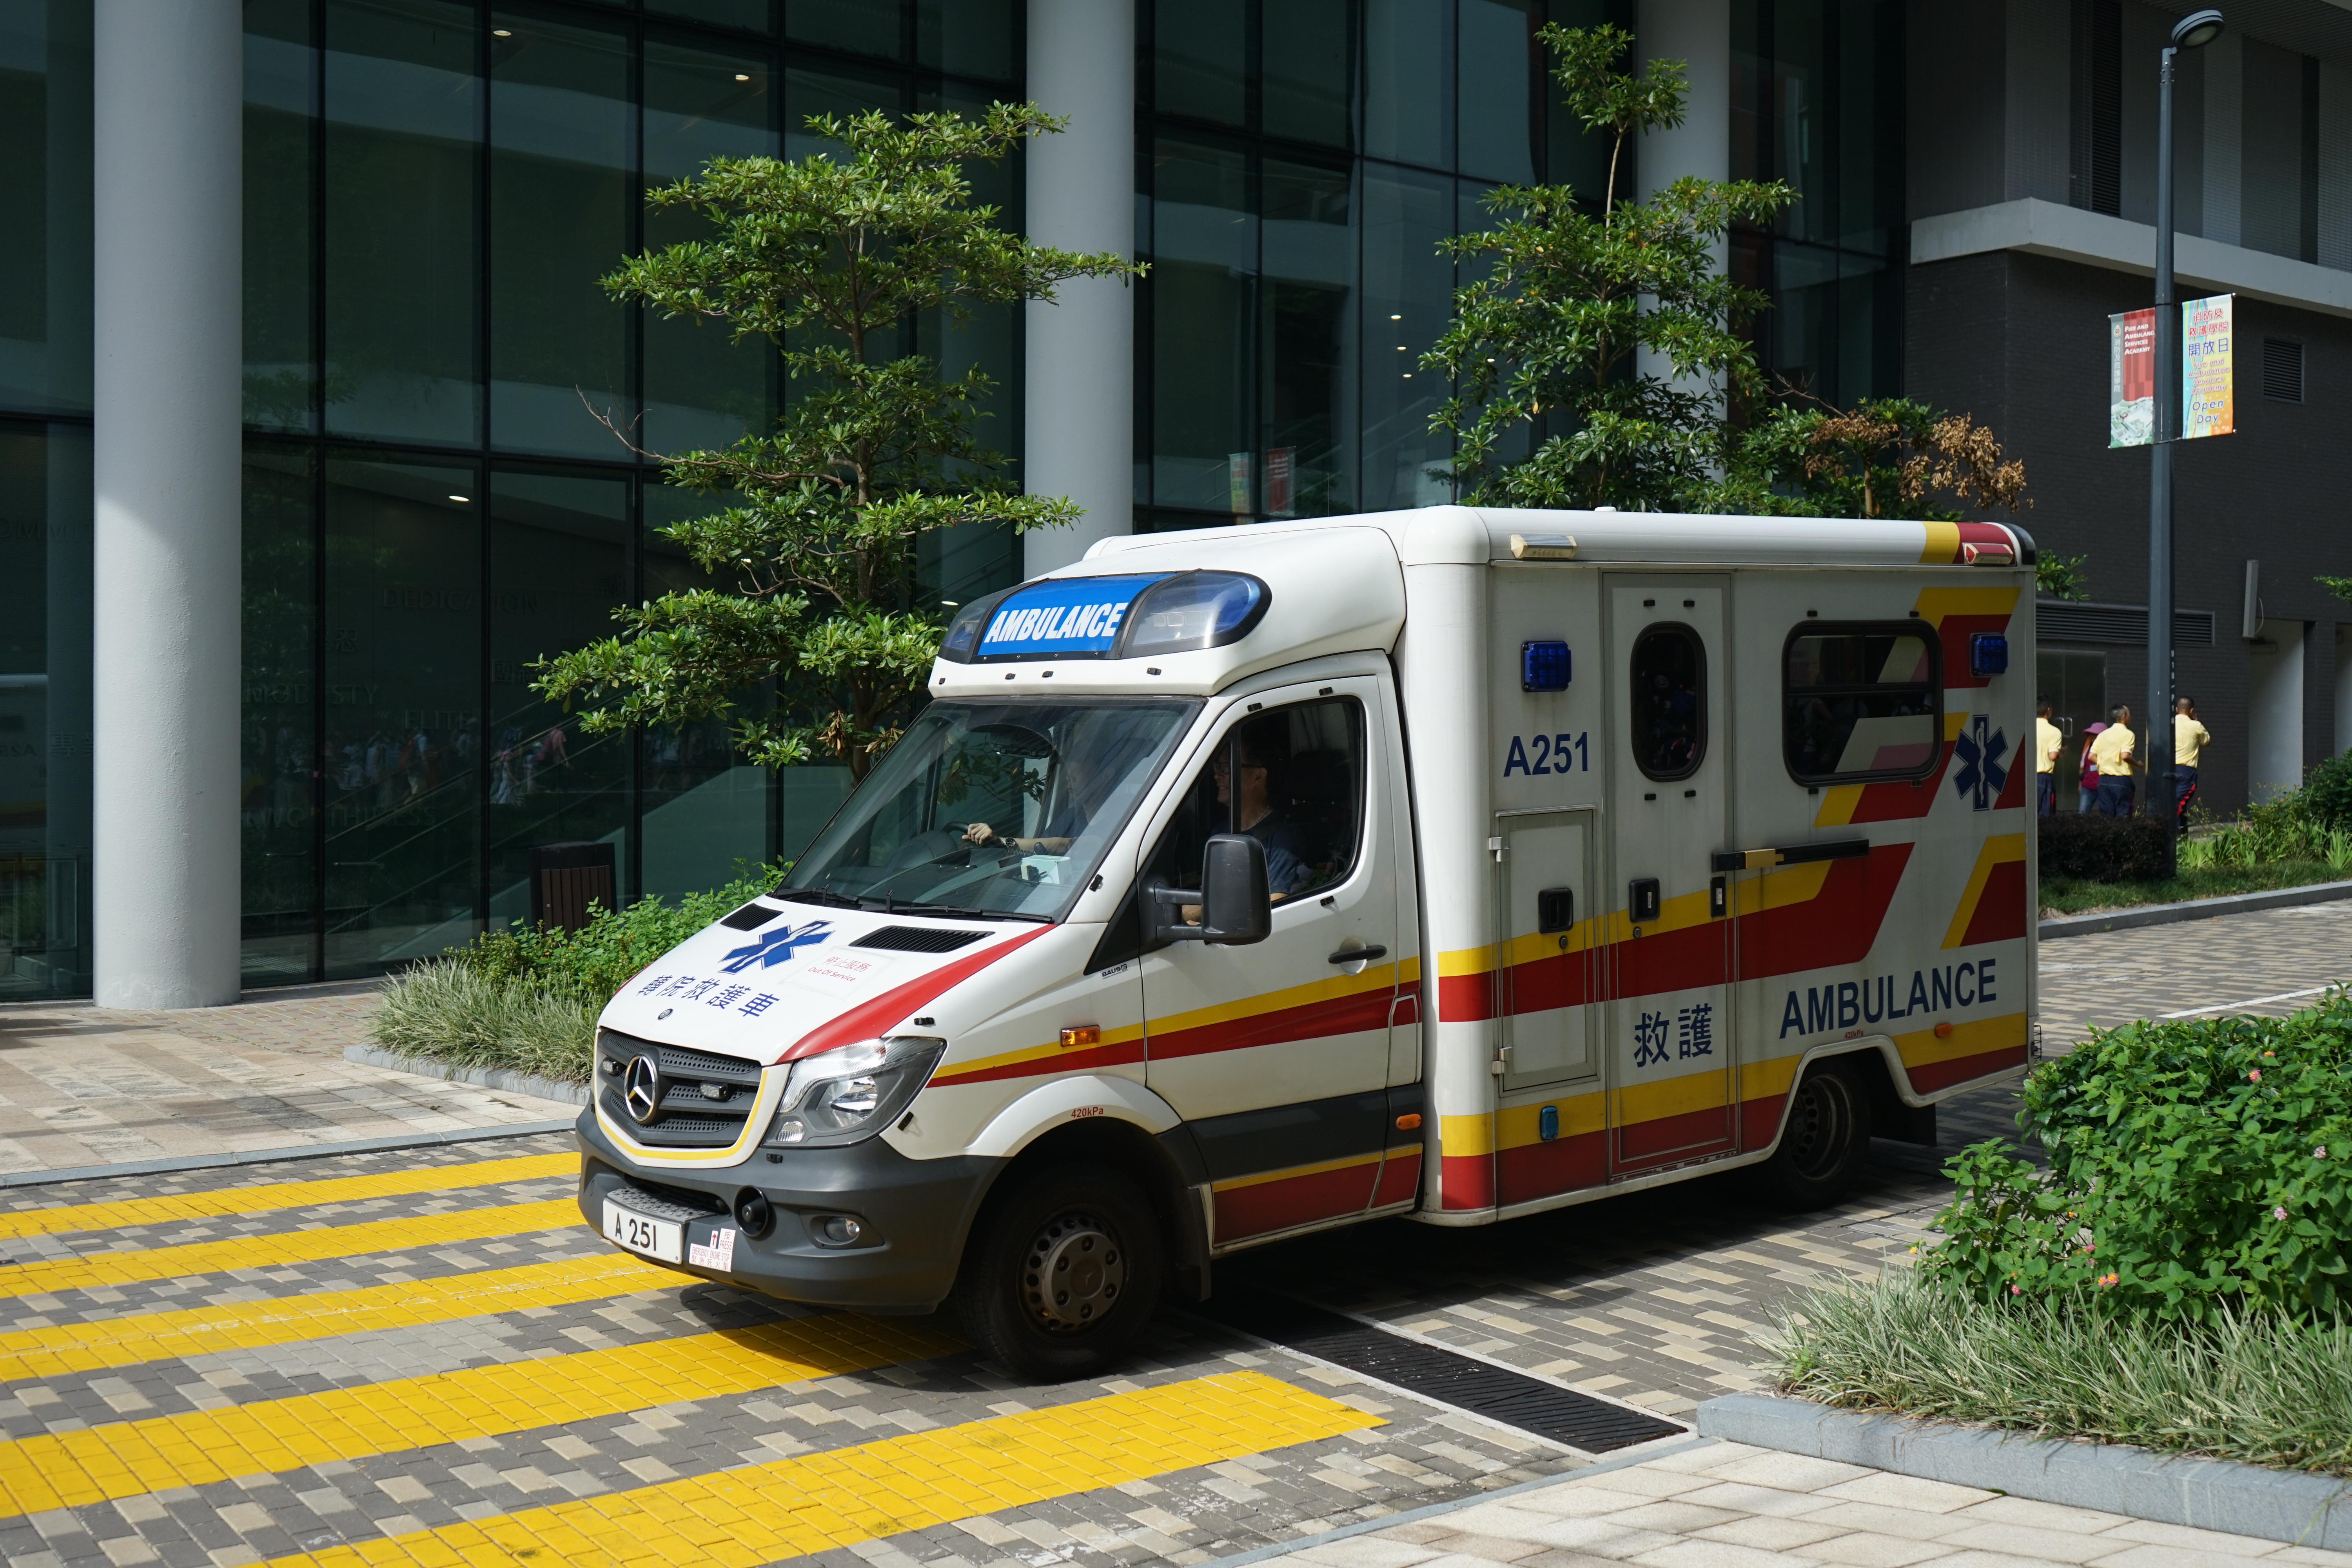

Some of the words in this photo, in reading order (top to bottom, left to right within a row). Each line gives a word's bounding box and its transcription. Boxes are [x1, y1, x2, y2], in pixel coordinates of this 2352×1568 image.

[2194, 309, 2222, 322] 消防及
[2125, 330, 2155, 340] AMBULANC
[2189, 321, 2228, 337] 救護學院
[2125, 339, 2148, 347] SERVICES
[2189, 338, 2228, 357] 開放日
[2125, 347, 2150, 355] ACADEMY
[2188, 367, 2229, 377] Ambulance
[2194, 376, 2223, 385] Services
[2191, 384, 2227, 394] Academy
[2192, 400, 2223, 412] Open
[2197, 414, 2219, 424] Day
[984, 602, 1129, 643] AMBULANCE
[1503, 732, 1590, 777] A251
[823, 956, 872, 972] 停止服務
[830, 971, 856, 982] Service
[1102, 966, 1121, 977] BAUS
[635, 975, 780, 1017] 轉院救護車
[1779, 958, 1997, 1040] AMBULANCE
[1634, 1003, 1713, 1068] 救護
[1845, 1030, 1864, 1039] 420kPa
[1071, 1106, 1103, 1118] 420kPa
[615, 1212, 622, 1240] A
[629, 1218, 656, 1251] 251
[724, 1230, 731, 1240] 按
[720, 1240, 732, 1250] PRESS
[692, 1247, 709, 1257] EMERGENCY
[710, 1250, 720, 1260] ENGINE
